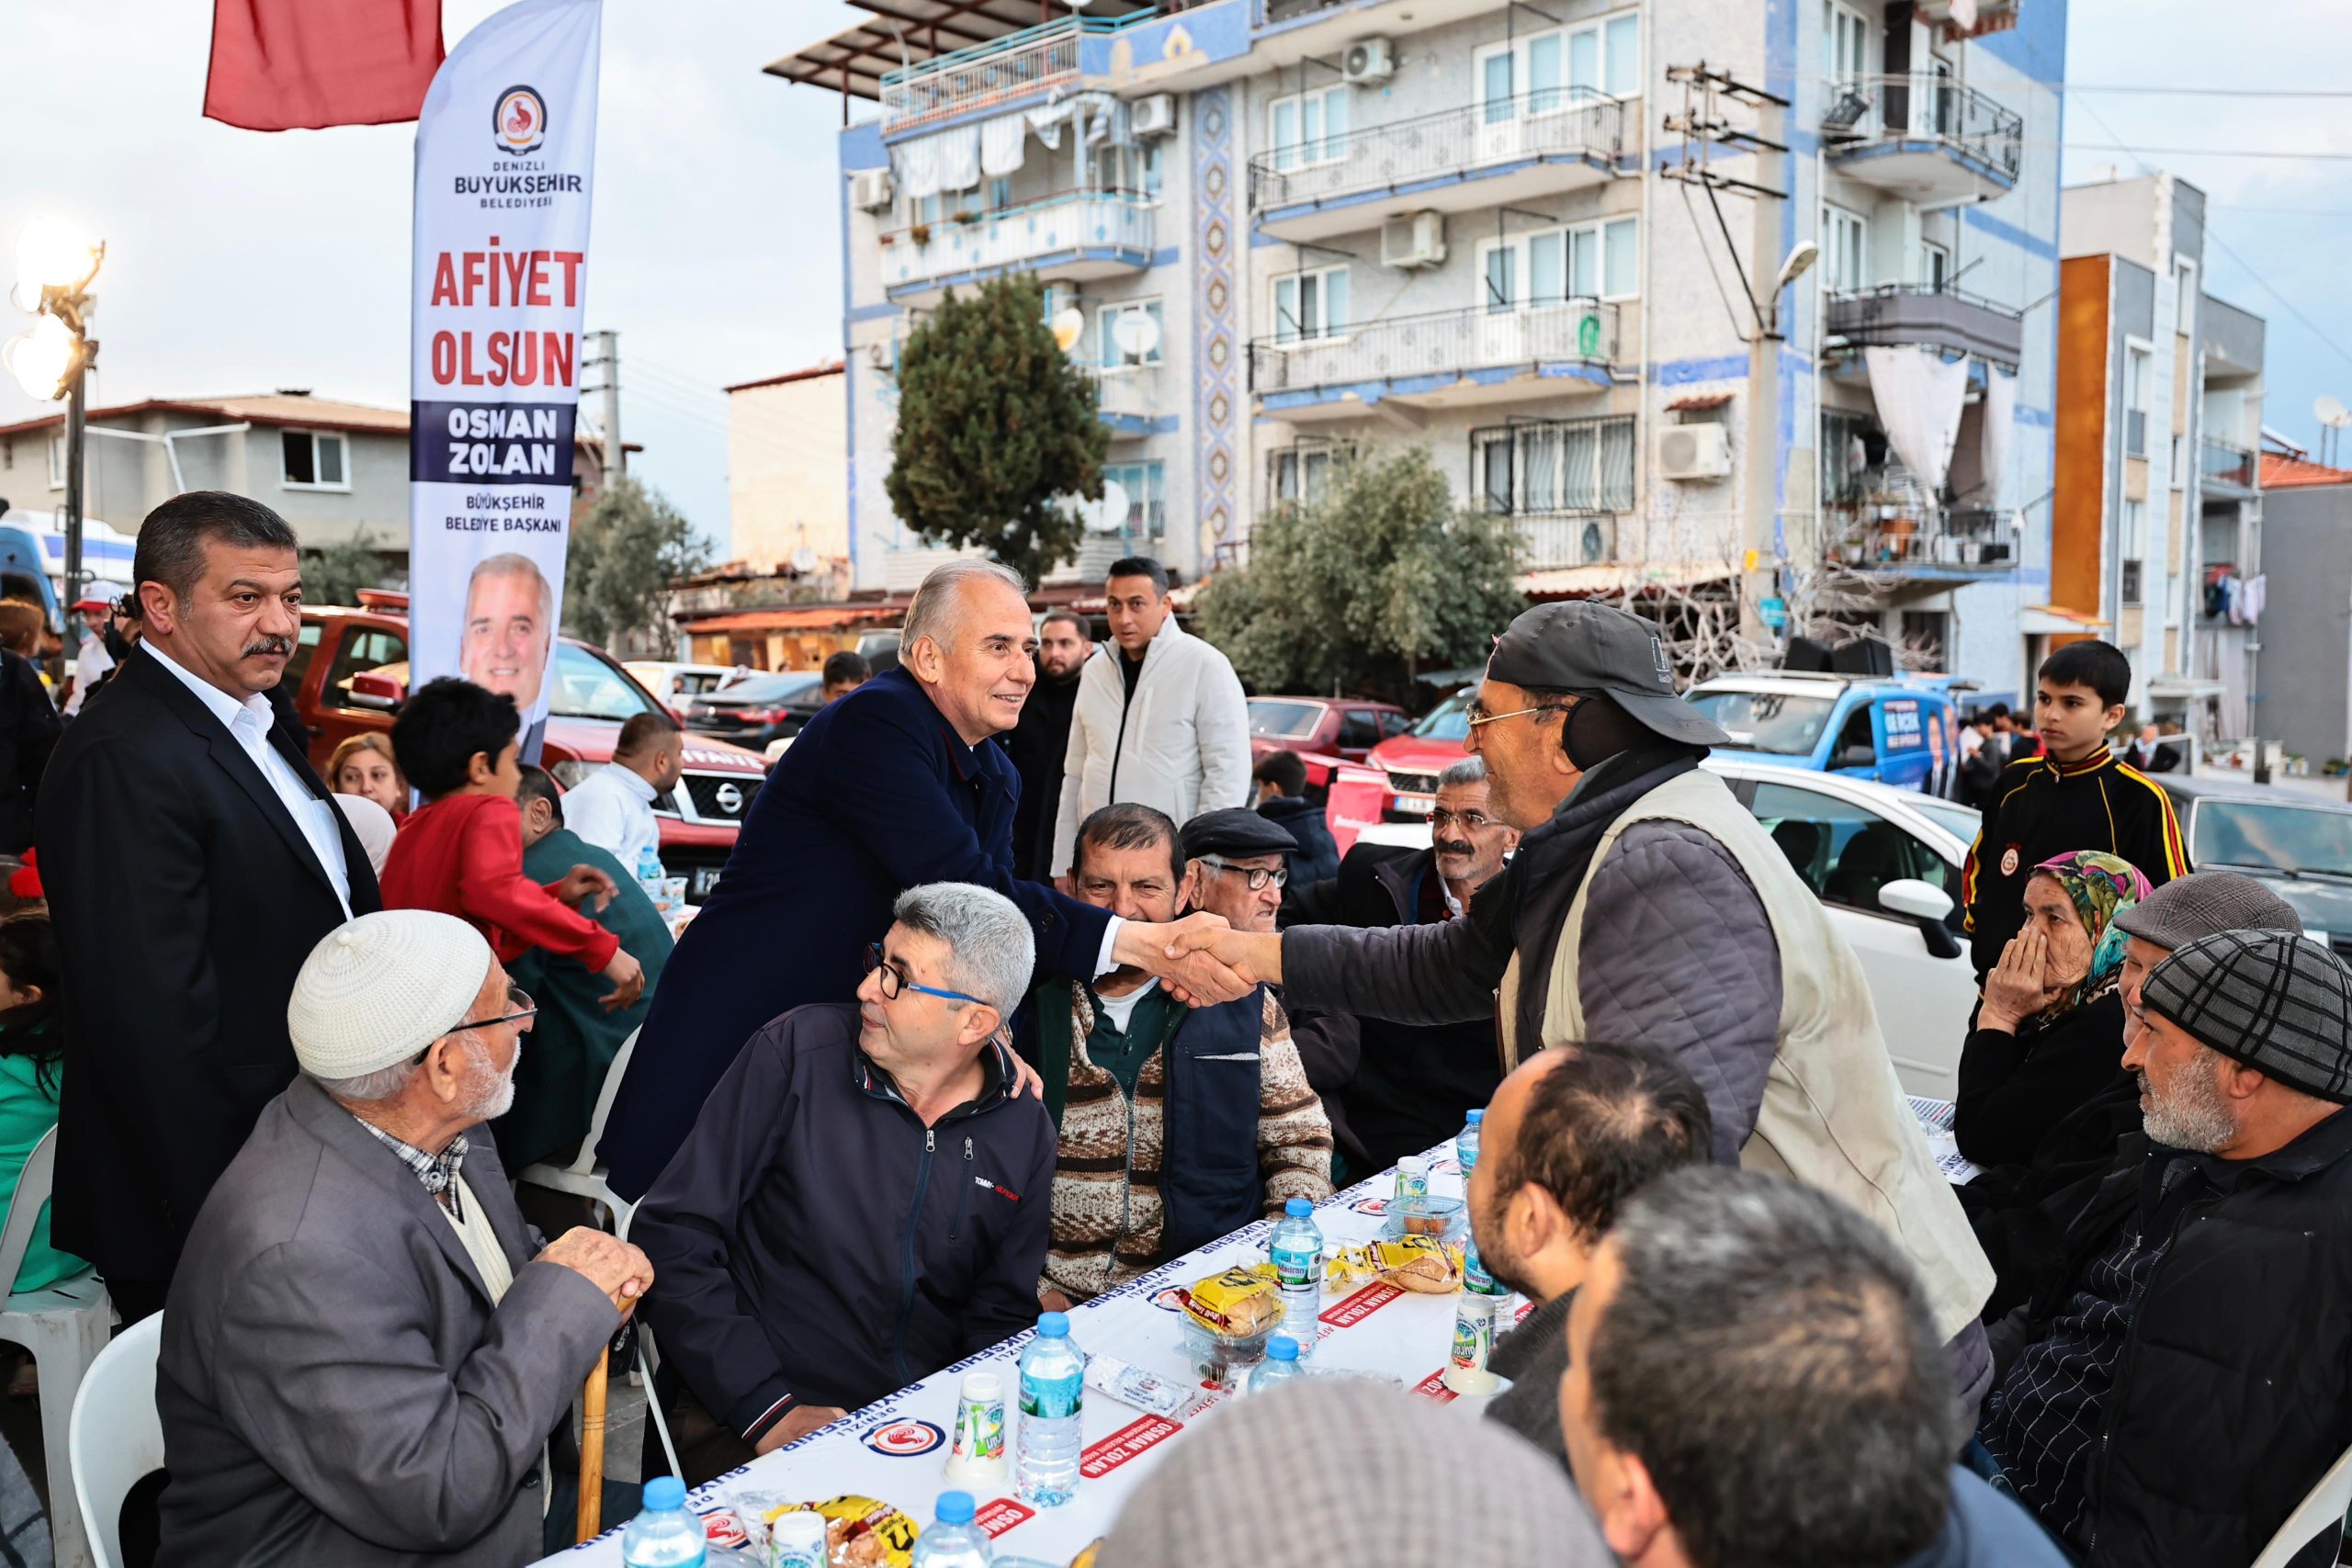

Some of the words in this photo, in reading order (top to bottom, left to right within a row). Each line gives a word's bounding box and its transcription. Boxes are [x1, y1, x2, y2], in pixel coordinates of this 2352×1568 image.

[431, 235, 584, 308] AFİYET
[431, 330, 574, 388] OLSUN
[447, 407, 558, 439] OSMAN
[448, 442, 556, 476] ZOLAN
[503, 517, 561, 534] BAŞKANI
[1363, 1286, 1399, 1308] OSMAN
[1334, 1305, 1371, 1325] ZOLAN
[1125, 1422, 1173, 1450] OSMAN
[1083, 1447, 1131, 1474] ZOLAN
